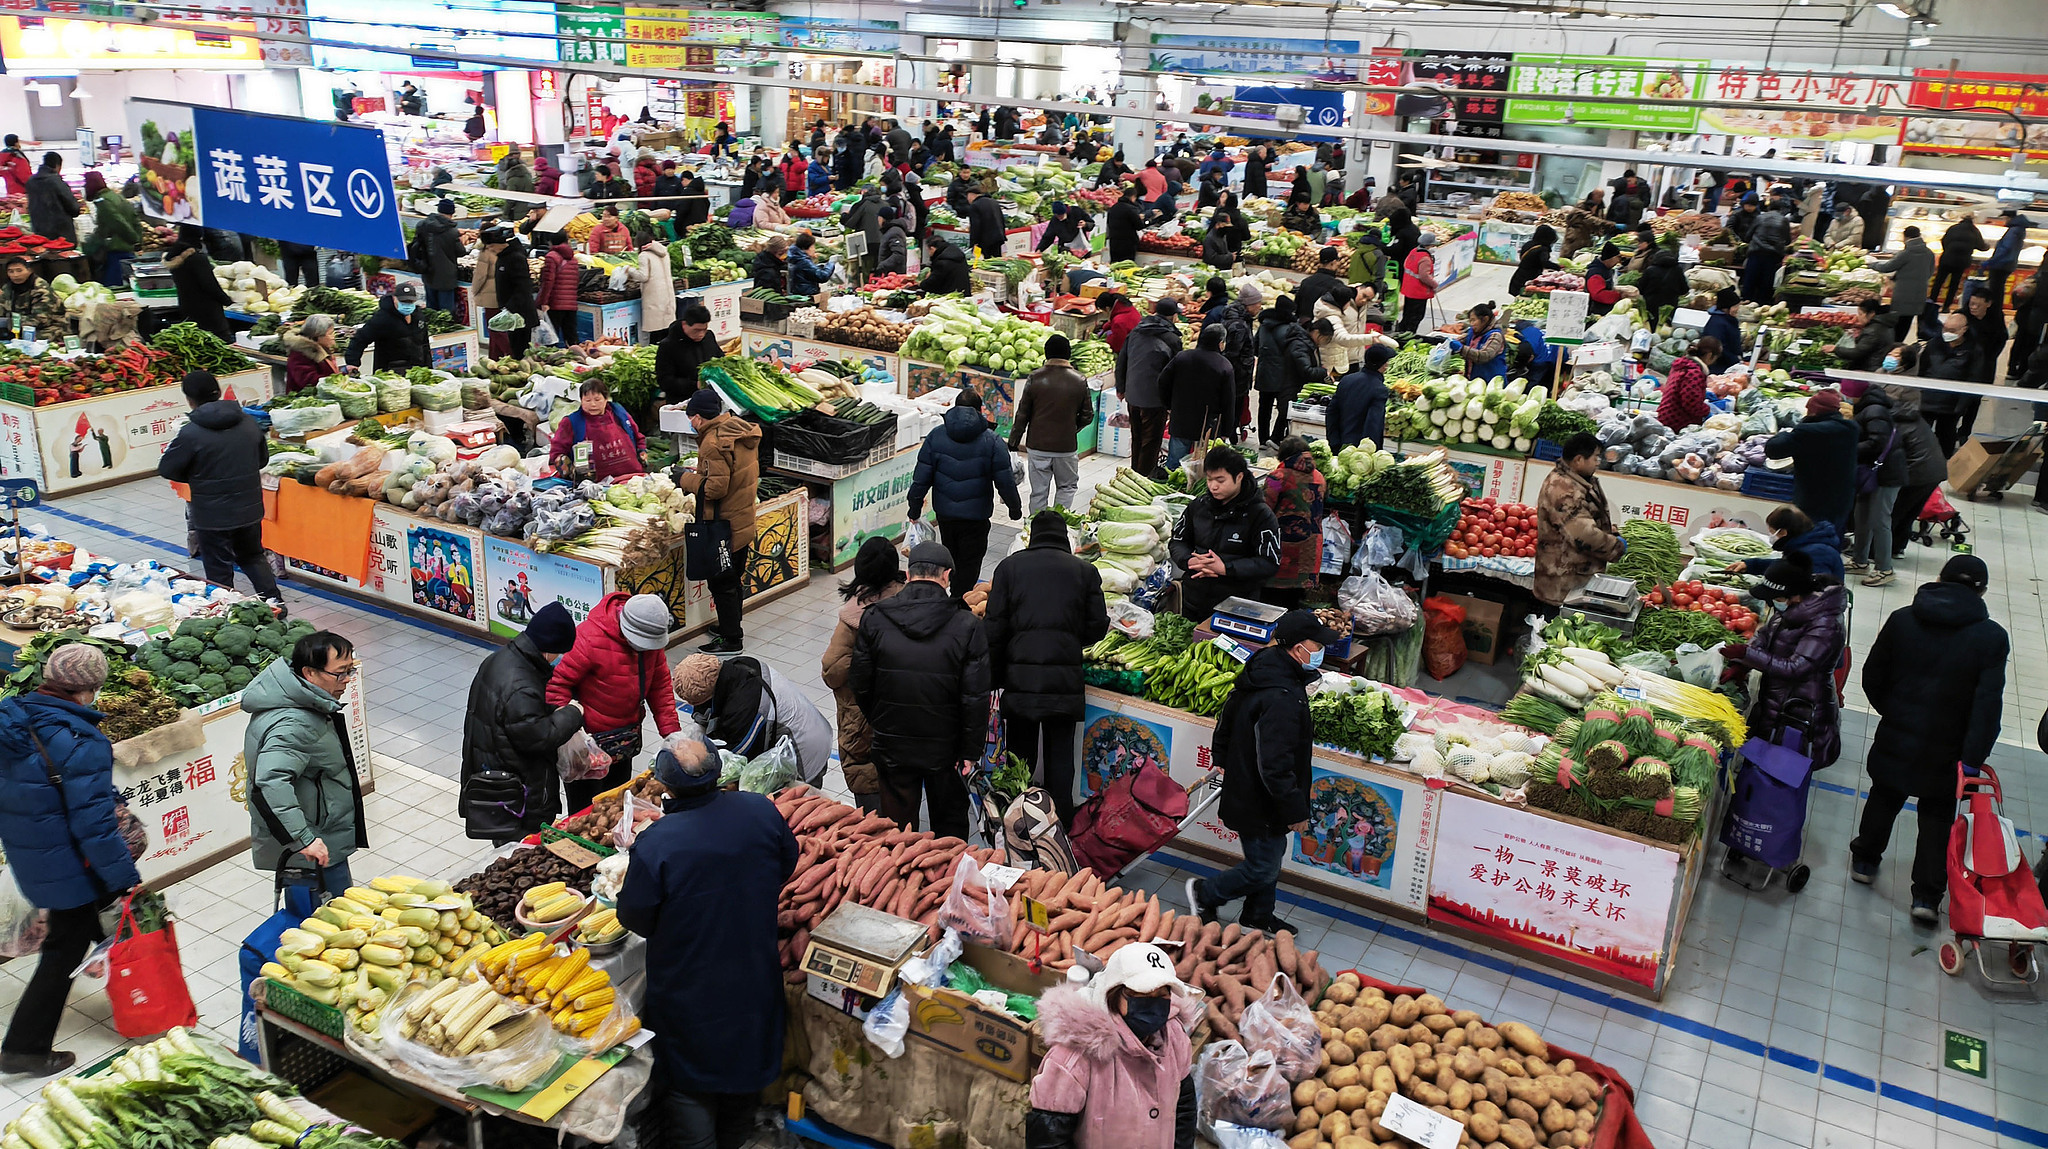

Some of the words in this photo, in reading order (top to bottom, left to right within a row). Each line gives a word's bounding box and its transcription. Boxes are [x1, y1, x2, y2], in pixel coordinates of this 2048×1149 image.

[209, 148, 343, 217] 蔬菜区
[130, 414, 184, 437] 中国前
[852, 480, 890, 512] 讲文明
[1621, 500, 1690, 528] 祝福祖国
[121, 768, 181, 800] 金龙飞舞
[184, 754, 216, 790] 福
[139, 780, 184, 807] 华夏得
[1420, 793, 1434, 846] 讲文明树新风
[1473, 844, 1632, 899] 一物一景莫破坏
[1468, 863, 1627, 922] 爱护公物齐关怀
[1146, 951, 1166, 970] R
